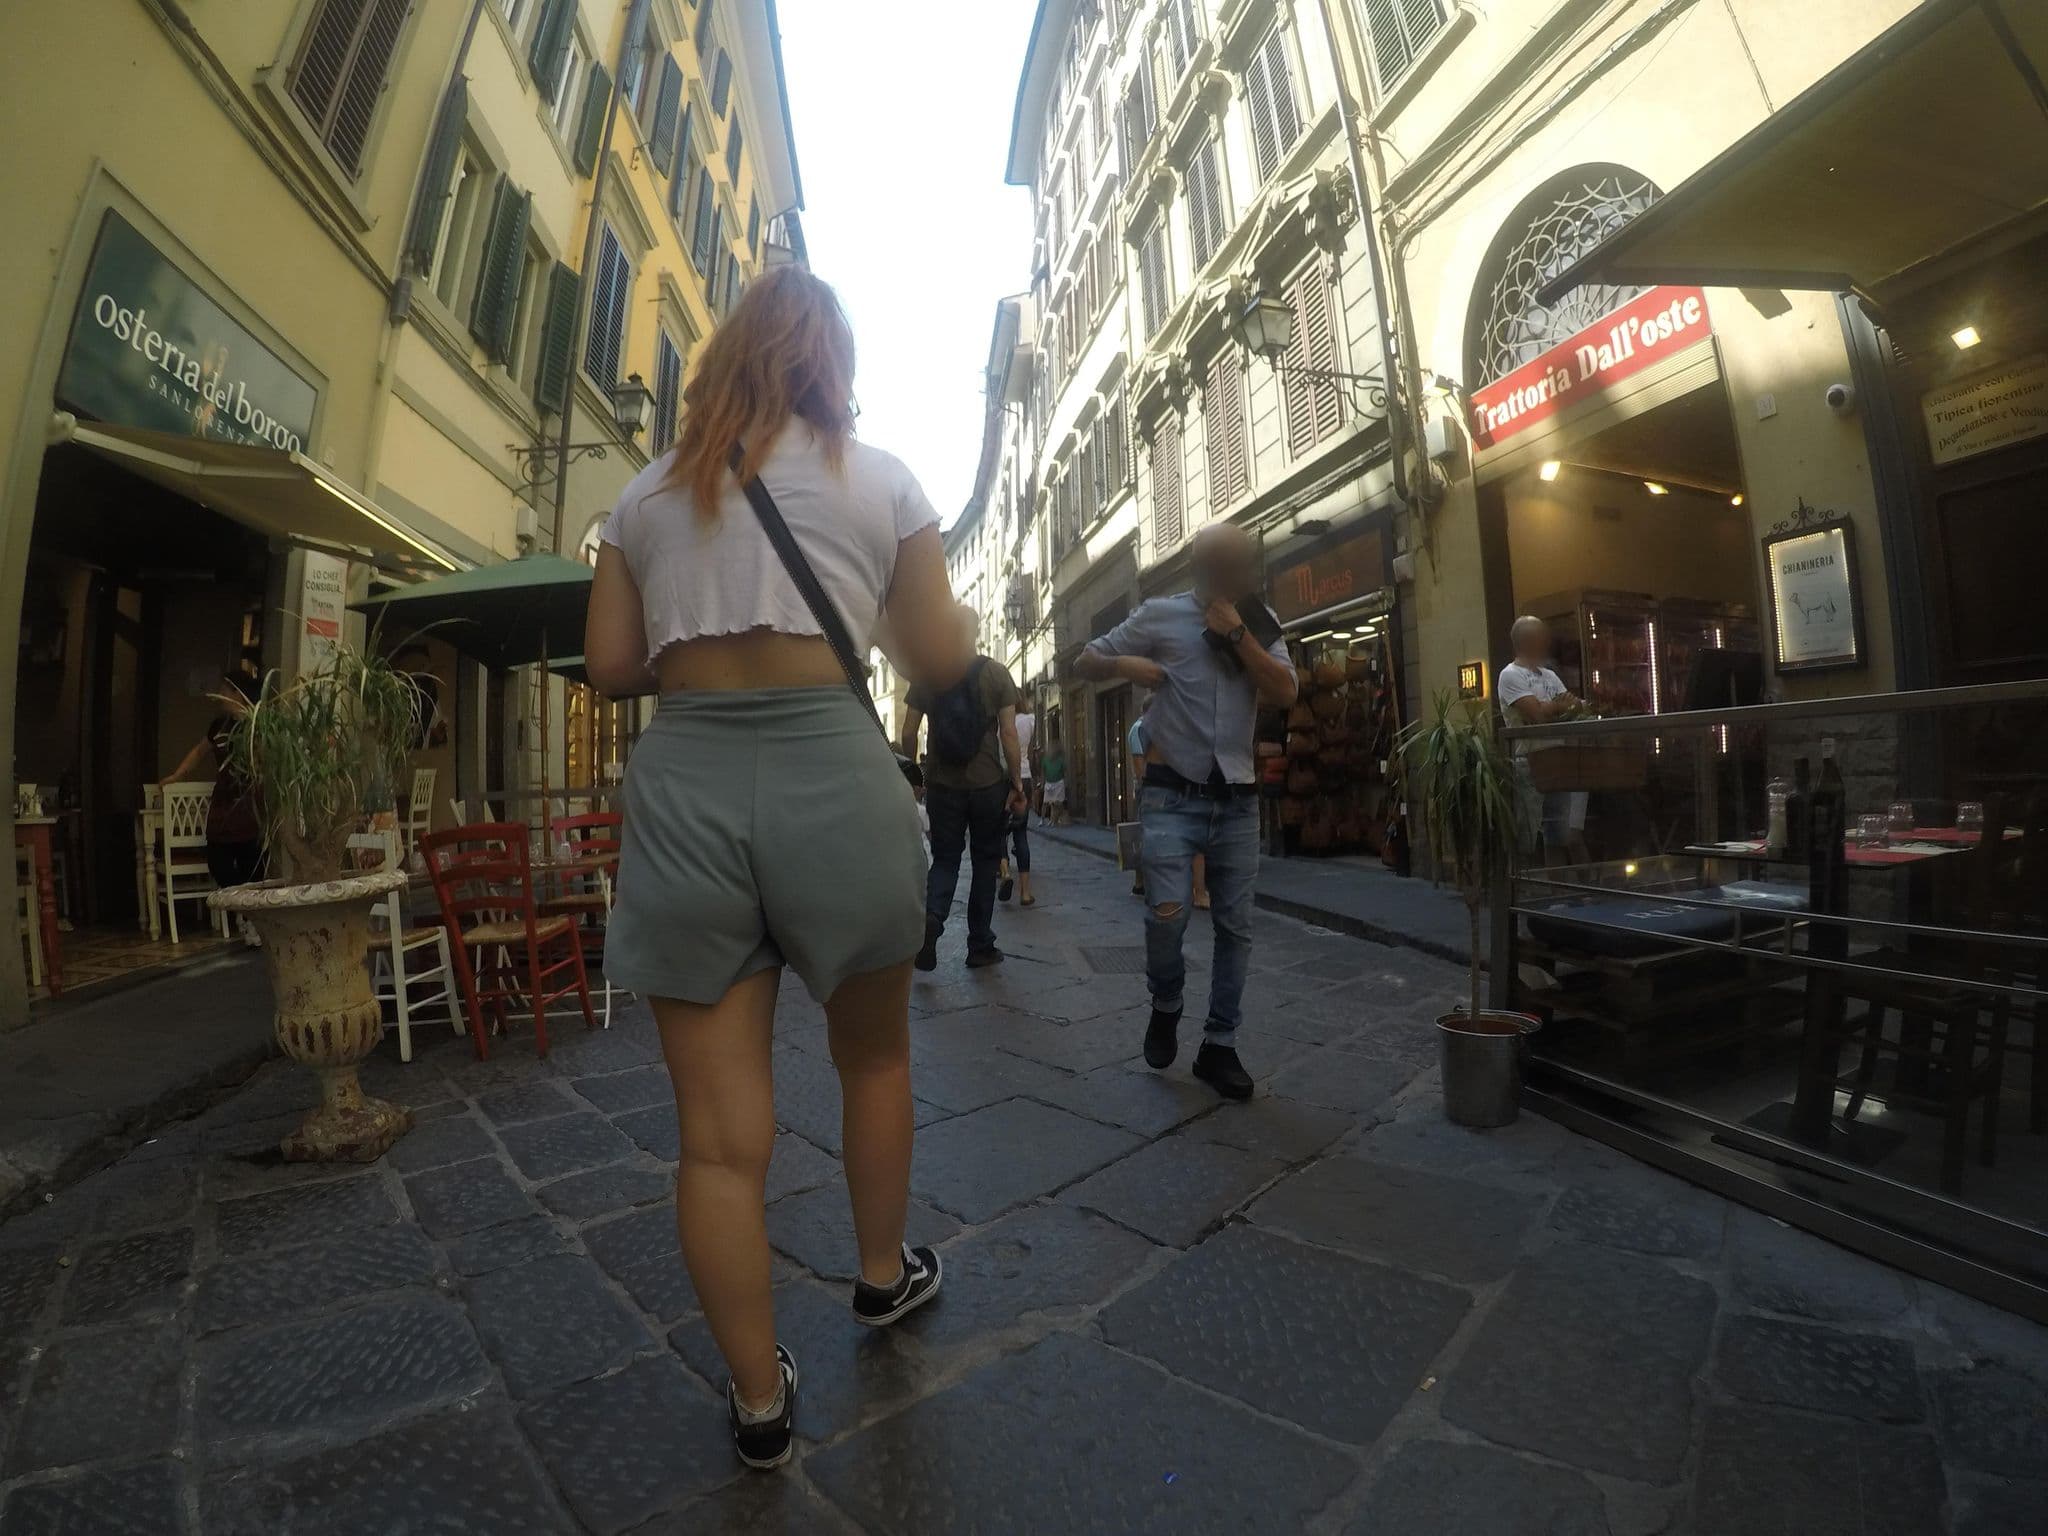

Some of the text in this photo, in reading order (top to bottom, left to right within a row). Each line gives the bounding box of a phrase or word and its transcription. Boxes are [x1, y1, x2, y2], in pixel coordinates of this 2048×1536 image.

[1475, 296, 1701, 436] Trattoria Dall'oste
[203, 372, 234, 414] del
[322, 570, 339, 581] CHEF
[1782, 554, 1835, 576] CHIANINERIA
